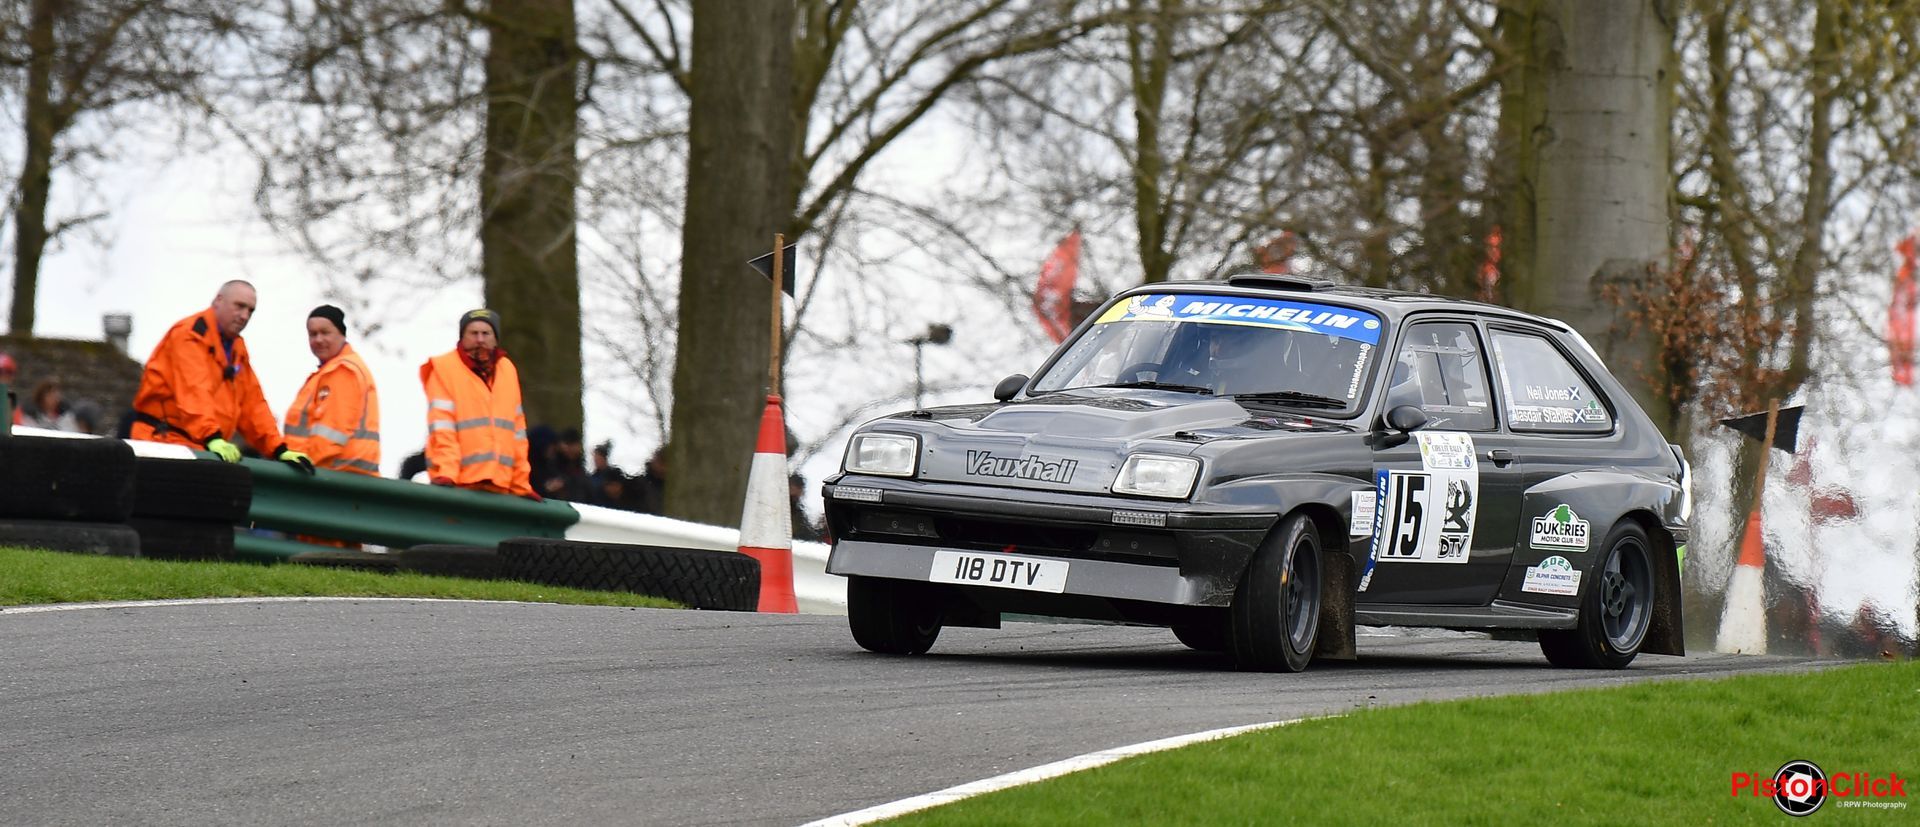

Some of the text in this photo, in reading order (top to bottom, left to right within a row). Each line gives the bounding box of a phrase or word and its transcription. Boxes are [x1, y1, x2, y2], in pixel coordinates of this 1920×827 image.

[1180, 302, 1359, 329] MICHELIN
[1526, 385, 1569, 400] Neil Jones
[1543, 407, 1574, 423] Stables
[966, 450, 1078, 484] Vauxhall
[1370, 476, 1386, 560] MICHELIN
[1388, 476, 1425, 556] 15
[1535, 522, 1585, 536] DUKERIES
[1437, 535, 1469, 558] DTV
[955, 556, 1041, 585] 118 DTV
[1542, 557, 1570, 571] 2023
